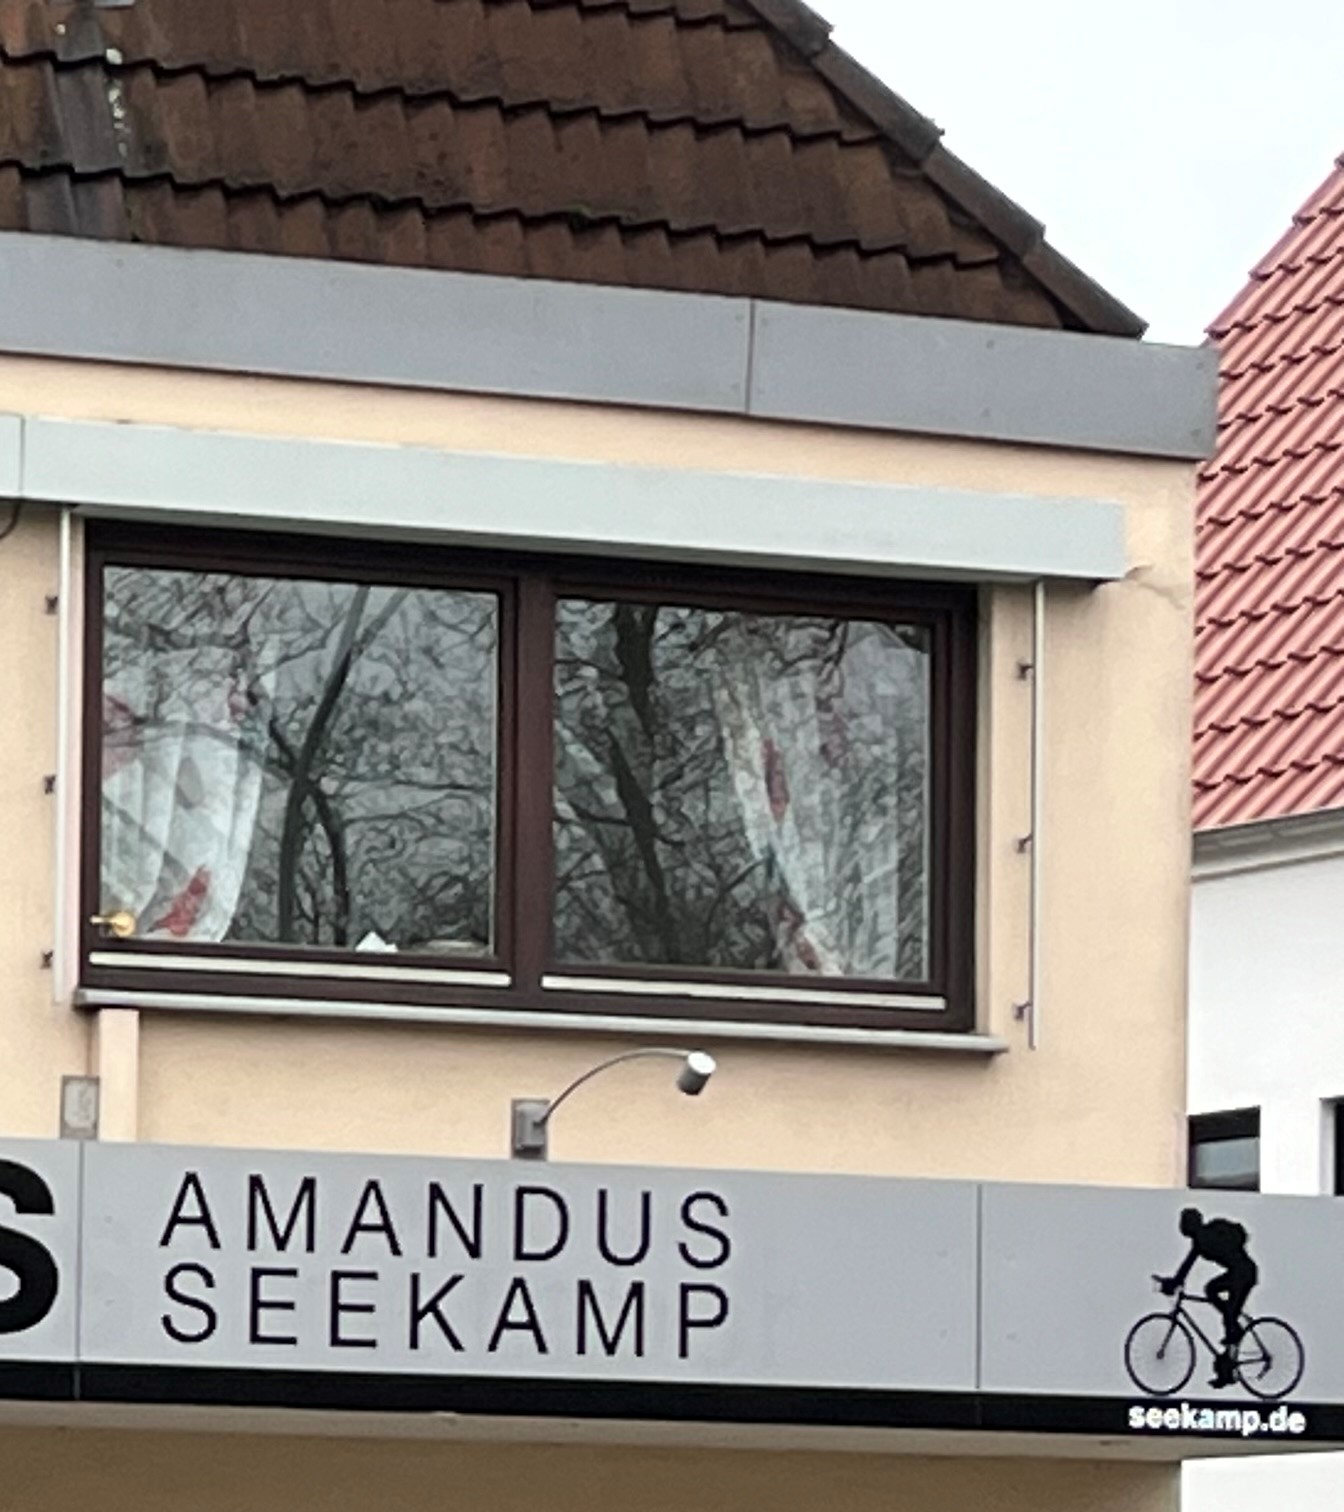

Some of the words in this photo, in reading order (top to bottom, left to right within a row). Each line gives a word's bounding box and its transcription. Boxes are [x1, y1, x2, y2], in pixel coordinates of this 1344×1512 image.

[159, 1170, 733, 1270] AMANDUS
[160, 1262, 731, 1360] SEEKAMP
[1128, 1402, 1307, 1436] seekamp.de
